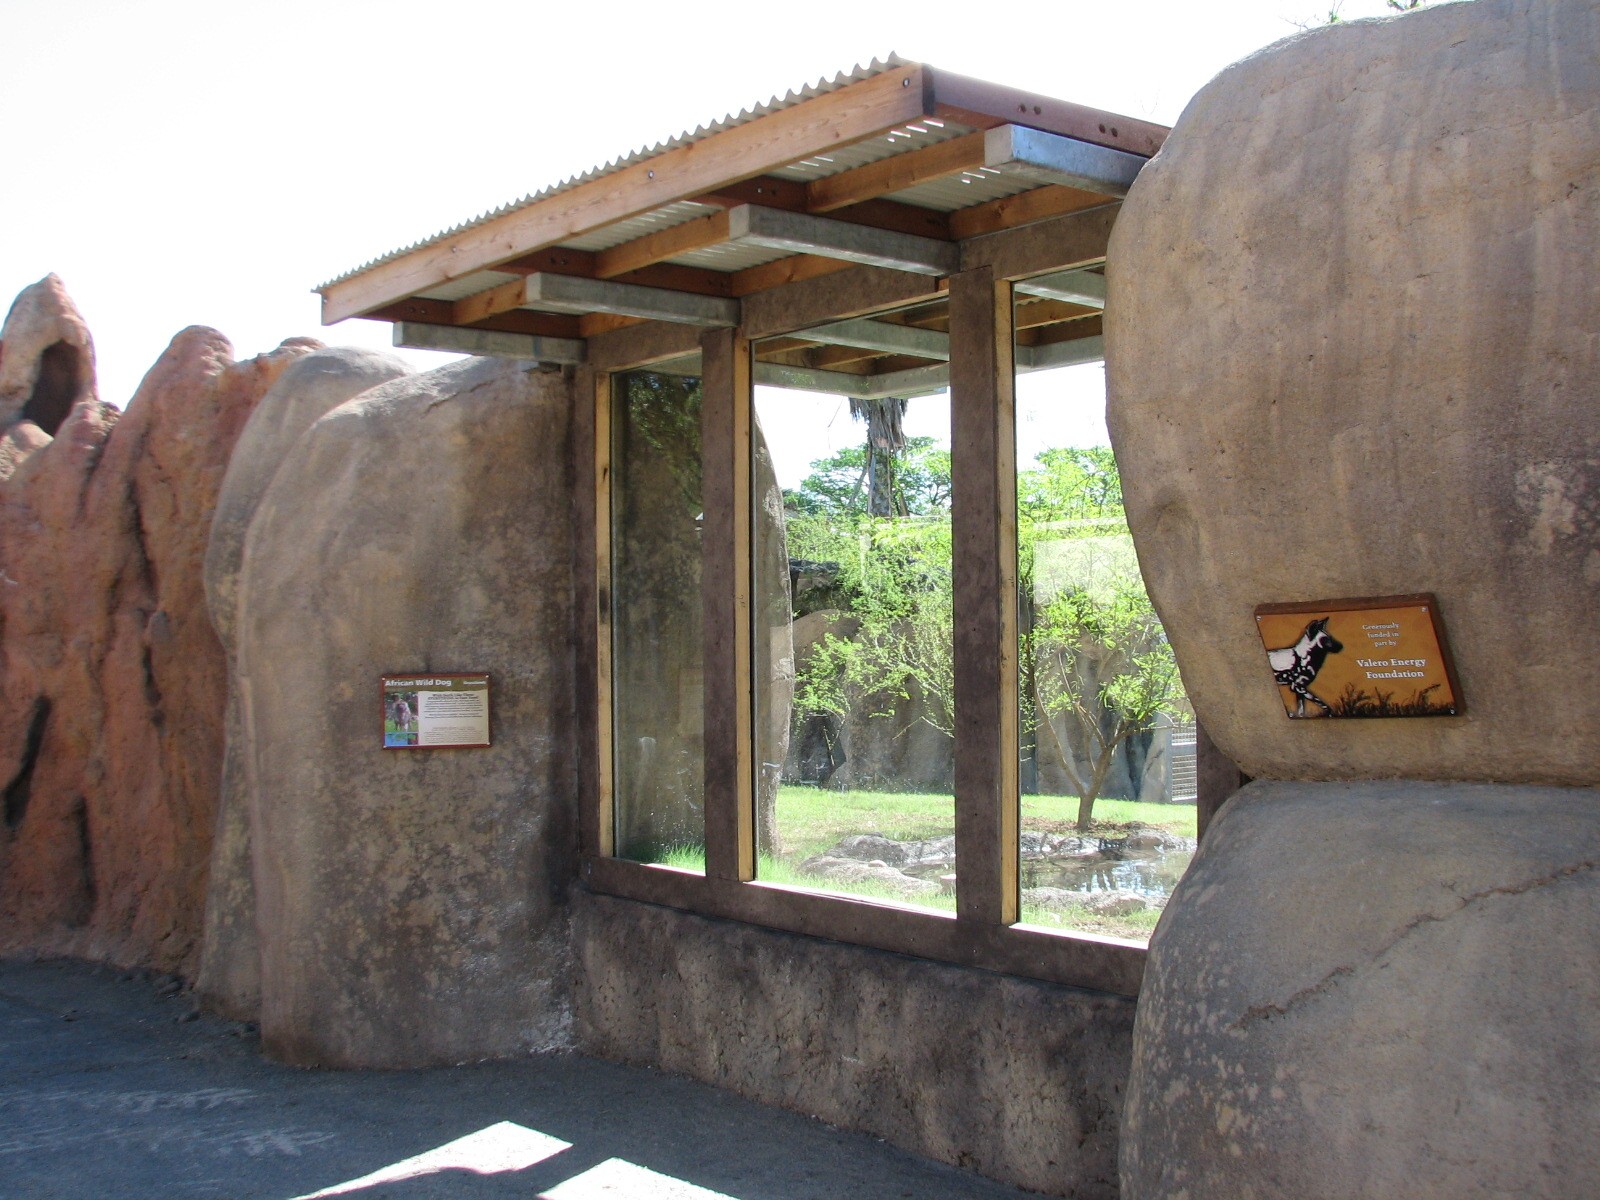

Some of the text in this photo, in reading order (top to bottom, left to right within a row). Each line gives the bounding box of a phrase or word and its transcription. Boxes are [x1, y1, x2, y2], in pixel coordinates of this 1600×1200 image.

[1361, 622, 1400, 630] Generously
[1374, 640, 1388, 648] part
[1356, 658, 1426, 668] Valero Energy
[1366, 669, 1424, 679] Foundation
[435, 679, 452, 687] Dog
